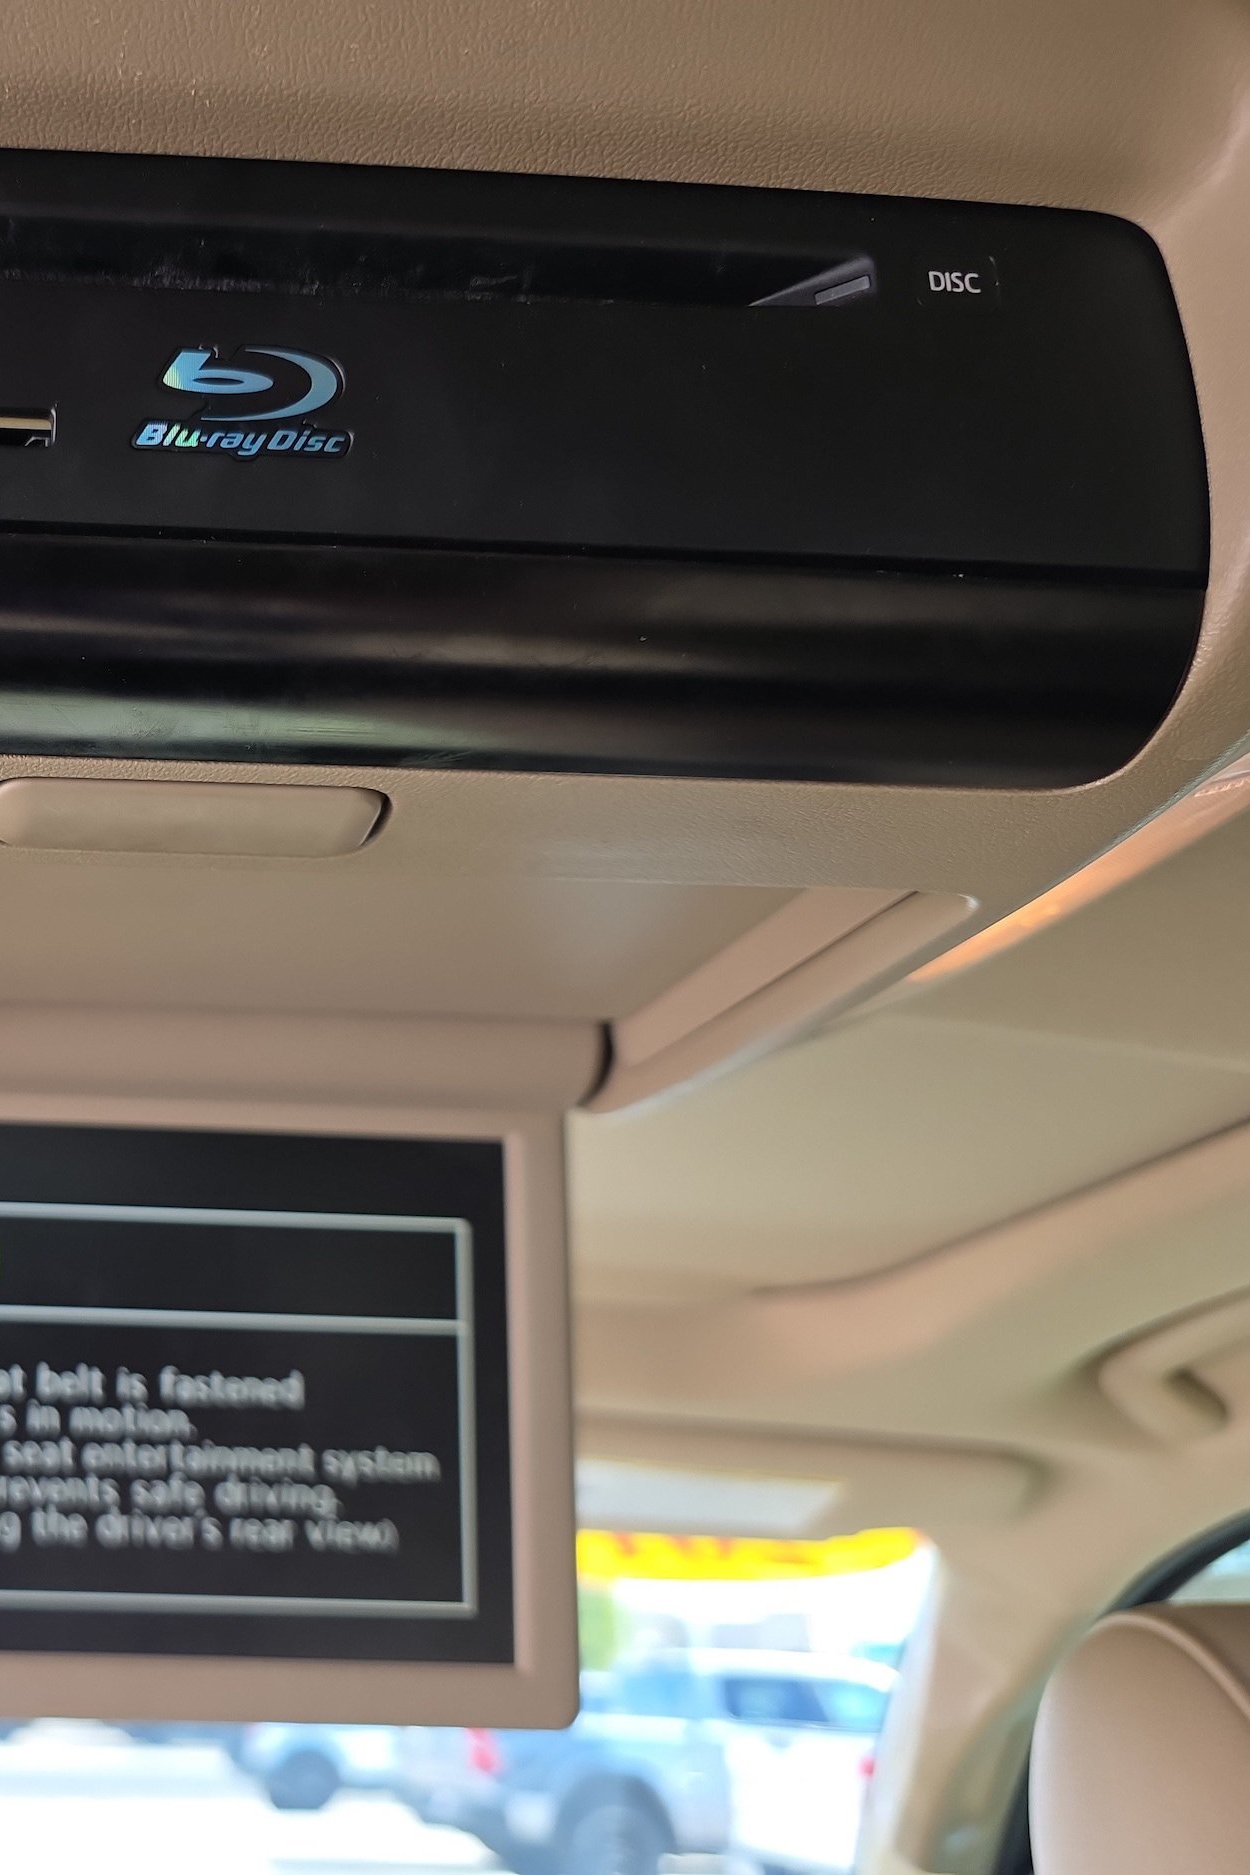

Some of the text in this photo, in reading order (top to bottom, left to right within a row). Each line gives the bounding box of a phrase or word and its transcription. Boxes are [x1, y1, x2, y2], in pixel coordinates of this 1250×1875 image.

[928, 270, 981, 293] DISC
[136, 421, 346, 456] Blu-ray Disc
[35, 1362, 105, 1405] belt
[116, 1366, 148, 1403] is
[159, 1366, 305, 1410] fastened
[26, 1399, 60, 1439] in
[2, 1437, 75, 1474] seat
[81, 1439, 316, 1482] entertainment
[322, 1446, 441, 1488] system
[130, 1471, 205, 1515] safe
[31, 1503, 88, 1547] the
[95, 1506, 223, 1551] driver's
[229, 1517, 297, 1553] rear
